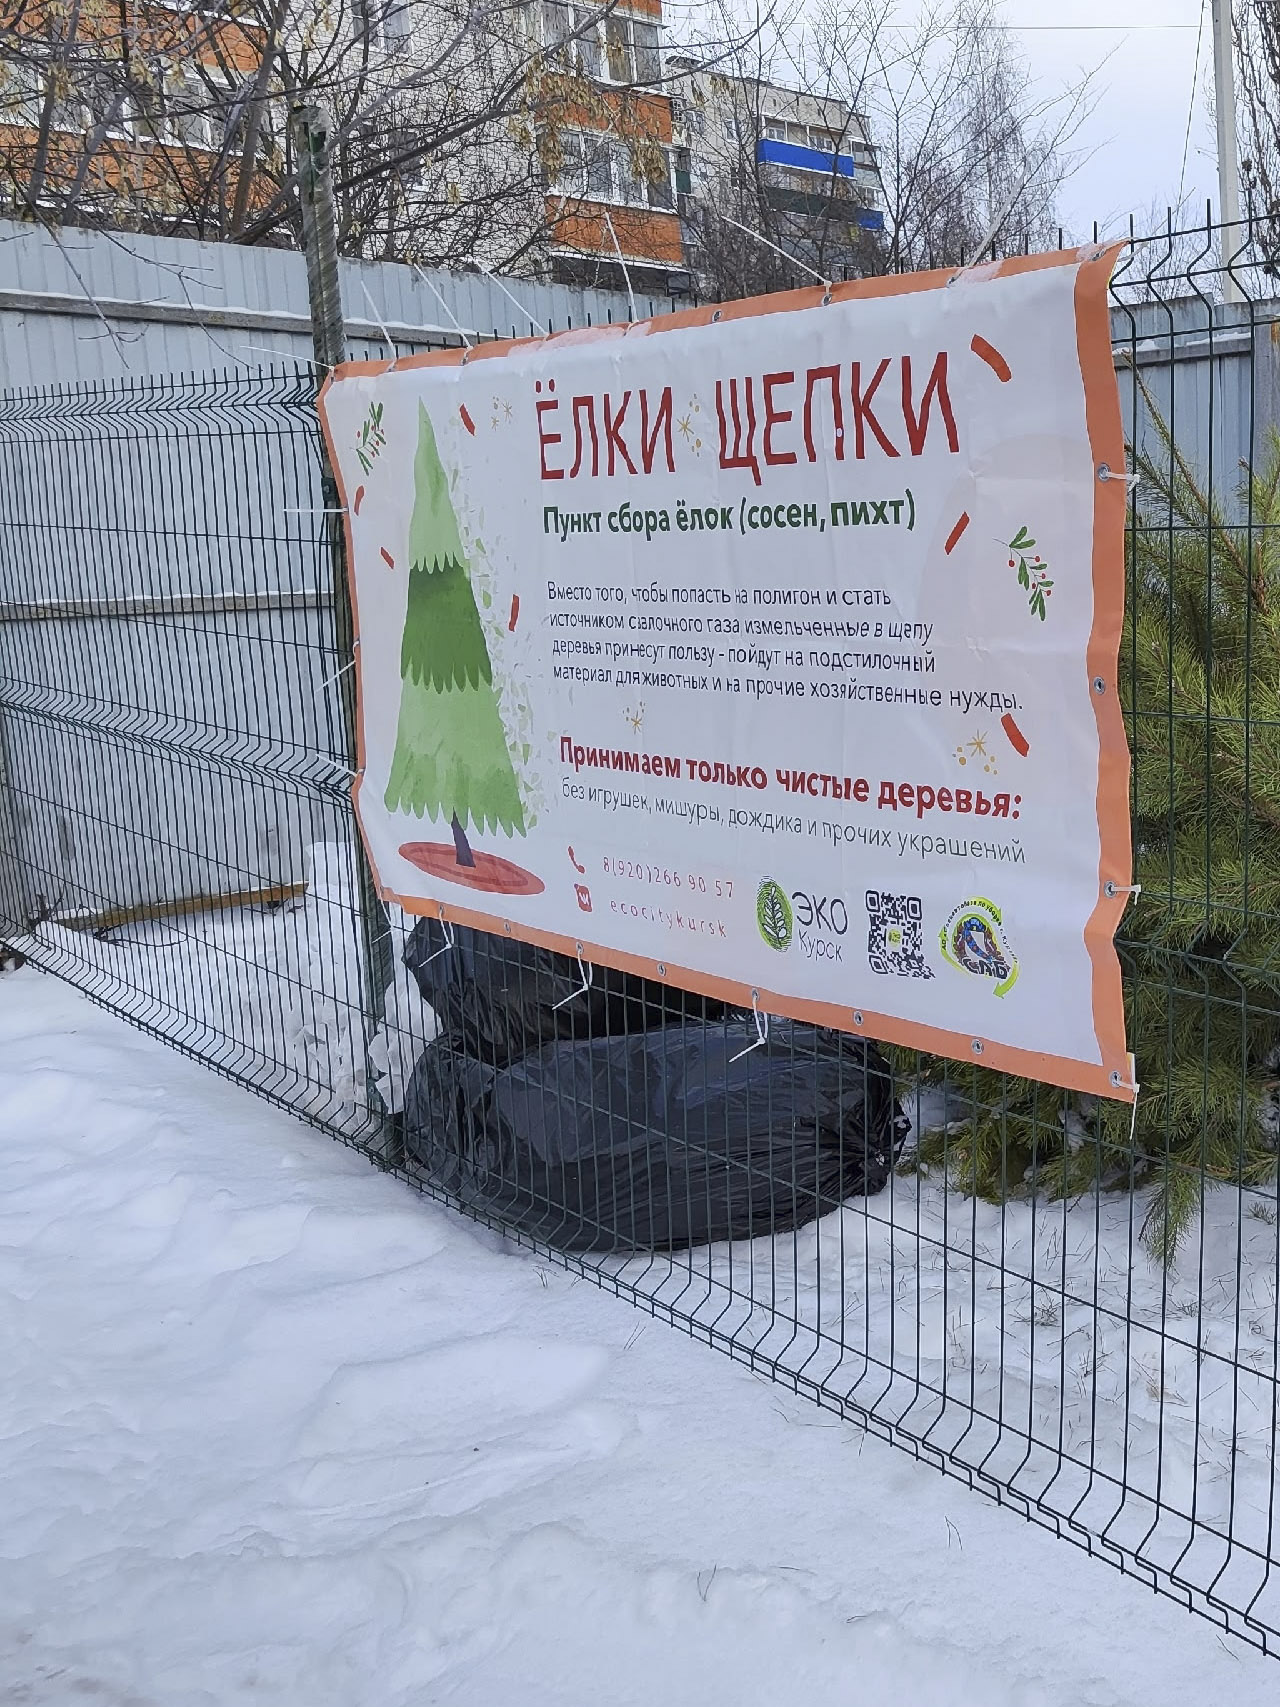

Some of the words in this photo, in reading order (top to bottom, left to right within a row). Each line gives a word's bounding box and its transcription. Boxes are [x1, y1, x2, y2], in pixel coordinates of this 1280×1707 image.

[536, 380, 676, 480] ЁЛКИ
[715, 351, 960, 486] ЩЕПКИ
[543, 506, 602, 542] Пункт
[607, 502, 670, 541] сбора
[676, 500, 734, 531] ёлок
[739, 497, 826, 535] (сосен,
[830, 488, 915, 531] пихт)
[548, 581, 592, 601] Вместо
[595, 587, 627, 604] того,
[632, 581, 668, 603] чтобы
[672, 587, 731, 603] попасть
[735, 588, 748, 603] на
[753, 589, 821, 605] полигон
[826, 590, 837, 605] и
[842, 589, 891, 605] стать
[550, 613, 624, 629] источником
[707, 618, 740, 633] газа
[744, 619, 870, 637] измельченные
[874, 622, 883, 637] в
[888, 622, 933, 646] щепу
[552, 639, 601, 658] деревья
[605, 641, 665, 664] принесут
[669, 645, 715, 667] пользу
[728, 643, 781, 670] пойдут
[785, 650, 803, 666] на
[809, 650, 935, 672] подстилочный
[553, 665, 612, 686] материал
[615, 671, 640, 687] для
[642, 672, 708, 690] животных
[712, 677, 721, 691] и
[726, 678, 740, 693] на
[746, 679, 805, 700] прочие
[810, 677, 942, 706] хозяйственные
[950, 690, 1023, 714] нужды.
[560, 736, 681, 779] Принимаем
[686, 759, 768, 790] только
[776, 769, 870, 802] чистые
[877, 781, 1022, 819] деревья:
[562, 777, 585, 800] без
[588, 785, 651, 814] игрушек,
[655, 797, 724, 826] мишуры,
[728, 808, 802, 834] дождика
[808, 819, 817, 836] и
[822, 821, 892, 847] прочих
[897, 831, 1026, 863] украшений
[603, 856, 681, 887] 8(920)266
[688, 874, 706, 893] 90
[715, 880, 733, 898] 57
[610, 900, 726, 938] ecocitykursk
[792, 892, 848, 935] ЭКО
[798, 928, 843, 962] Курск
